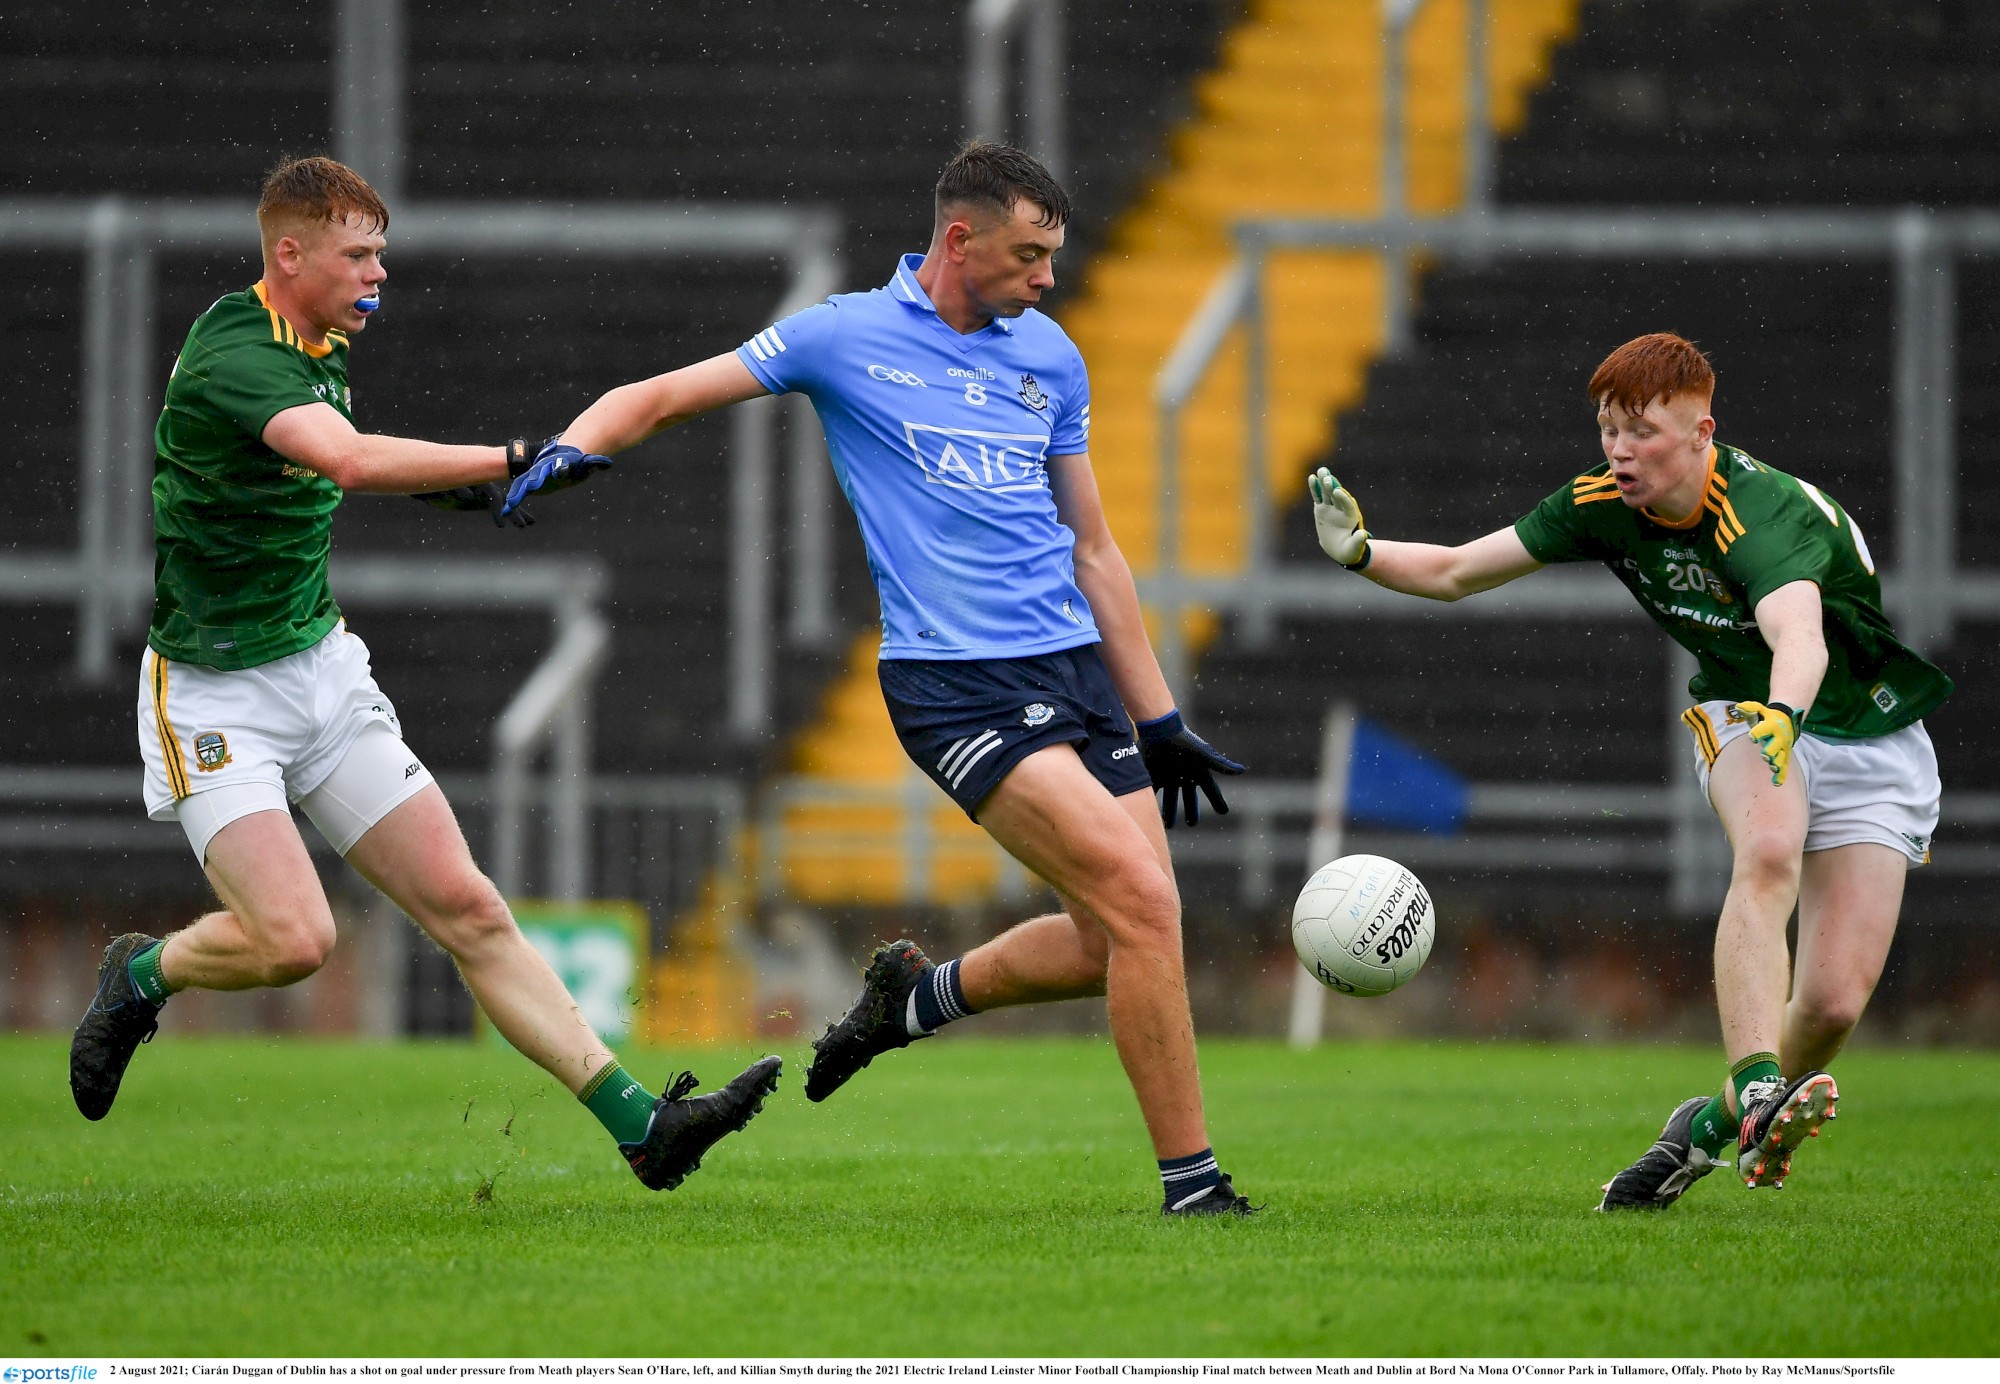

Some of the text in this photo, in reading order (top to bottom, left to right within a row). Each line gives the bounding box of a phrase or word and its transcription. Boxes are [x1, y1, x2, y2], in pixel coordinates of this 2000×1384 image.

[964, 382, 988, 406] 8
[936, 441, 1033, 483] AIG
[1666, 562, 1706, 592] 20
